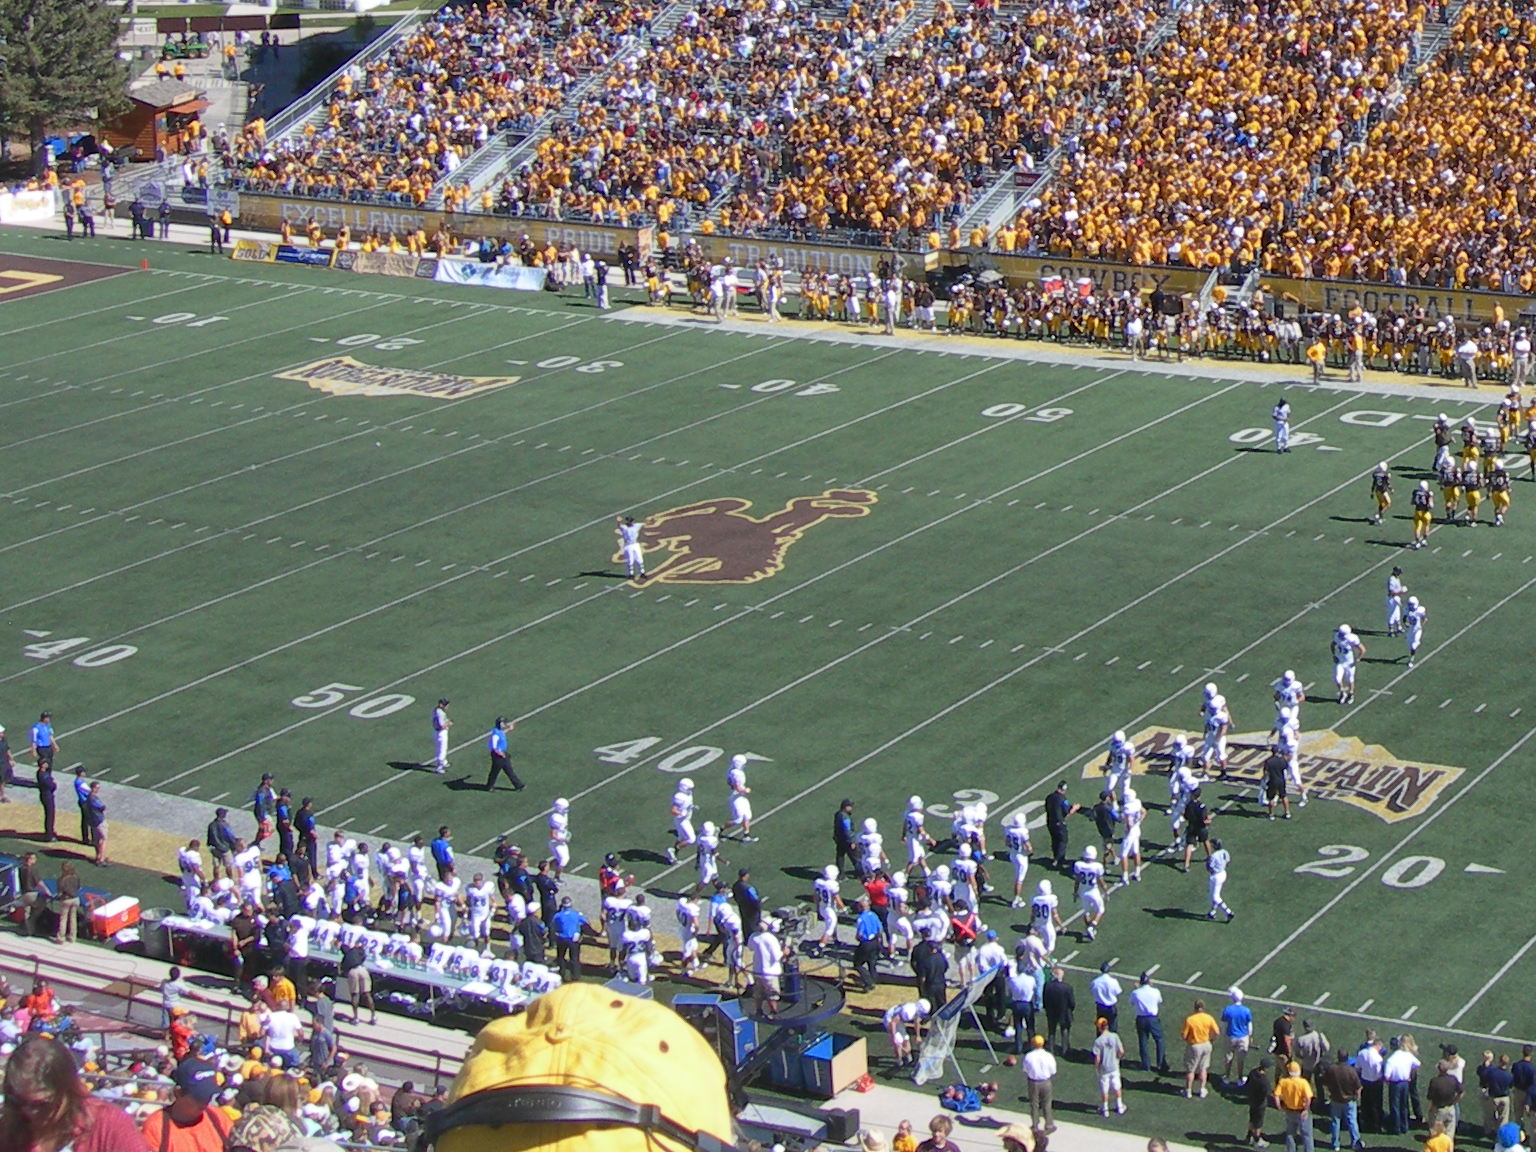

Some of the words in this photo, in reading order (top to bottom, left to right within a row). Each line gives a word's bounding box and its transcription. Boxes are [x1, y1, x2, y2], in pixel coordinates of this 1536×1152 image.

[544, 226, 617, 254] PRIDE
[22, 637, 139, 668] 40
[291, 682, 417, 720] 50
[593, 735, 725, 774] 40
[1080, 871, 1096, 886] 32
[1293, 844, 1447, 890] 20
